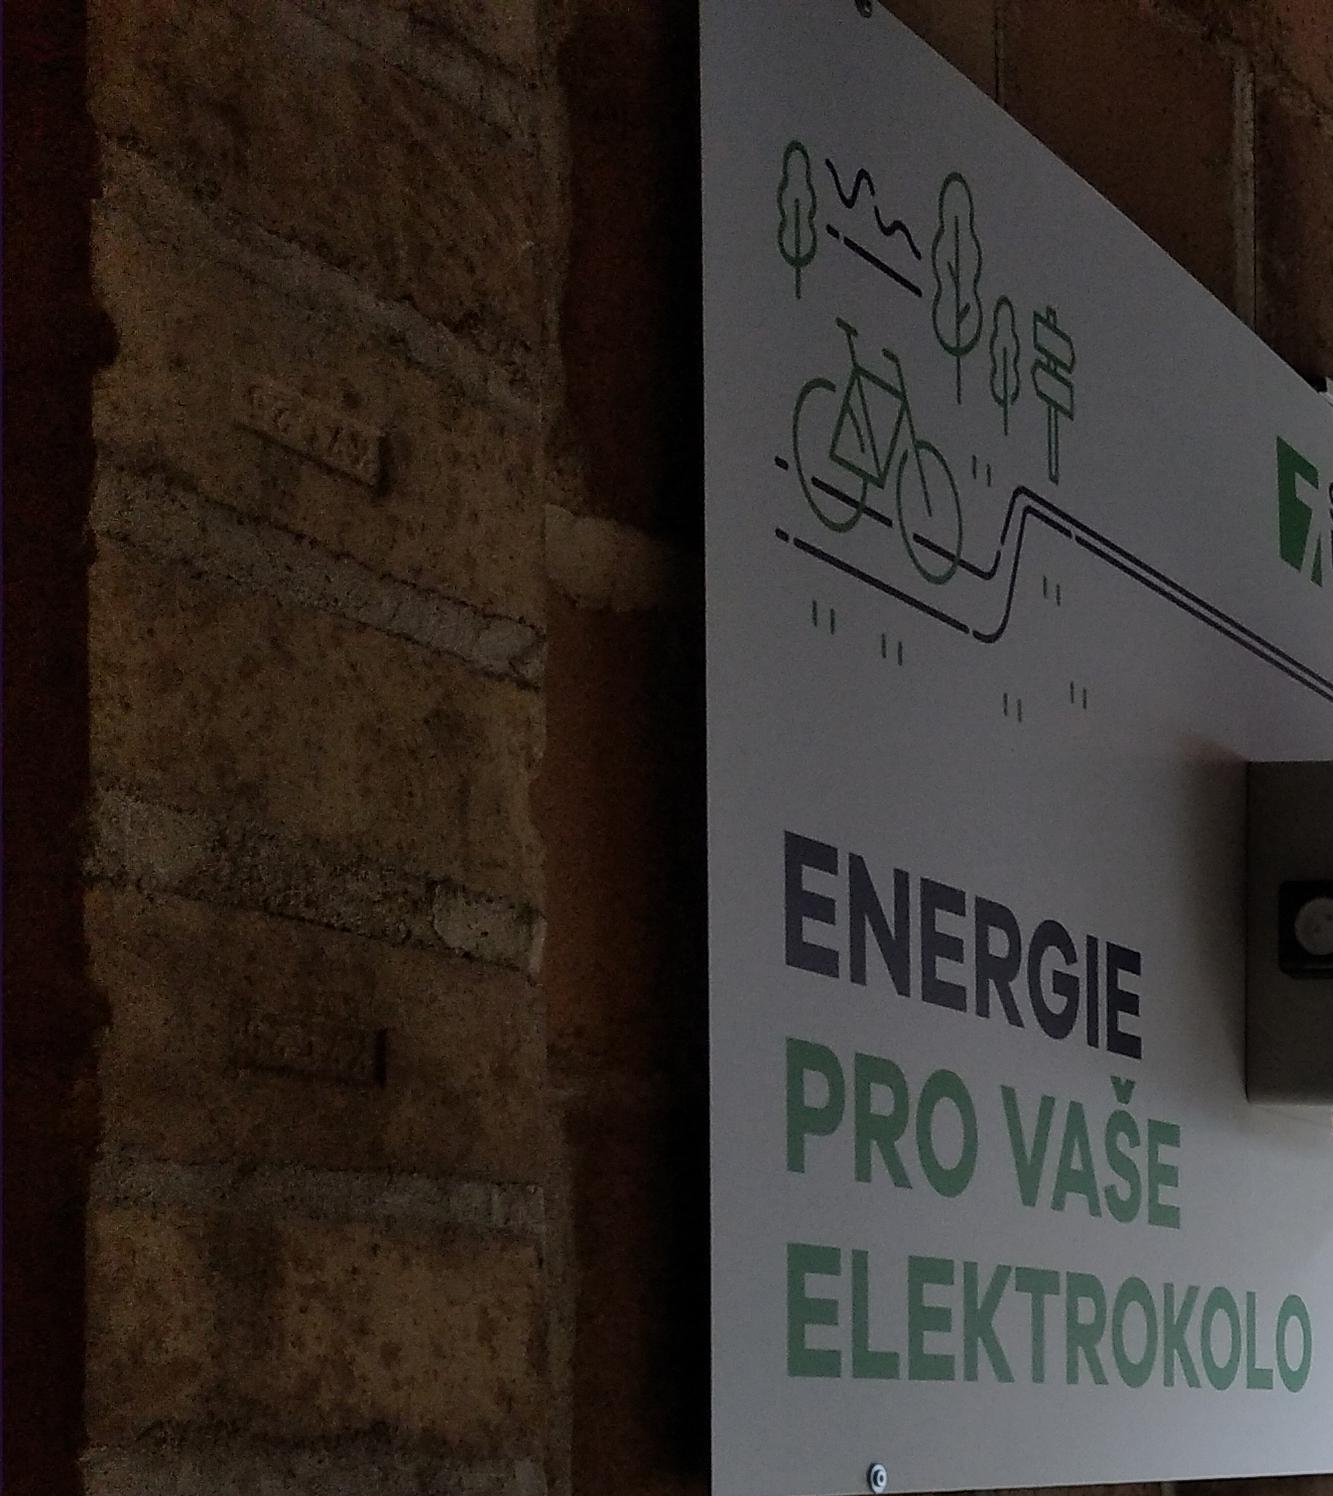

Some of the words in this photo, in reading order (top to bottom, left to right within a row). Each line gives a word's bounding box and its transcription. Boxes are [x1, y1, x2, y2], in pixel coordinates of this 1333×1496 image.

[783, 829, 1142, 1060] ENERGIE
[785, 1037, 979, 1198] PRO
[1001, 1075, 1181, 1229] VAŠE
[784, 1241, 1313, 1394] ELEKTROKOLO
